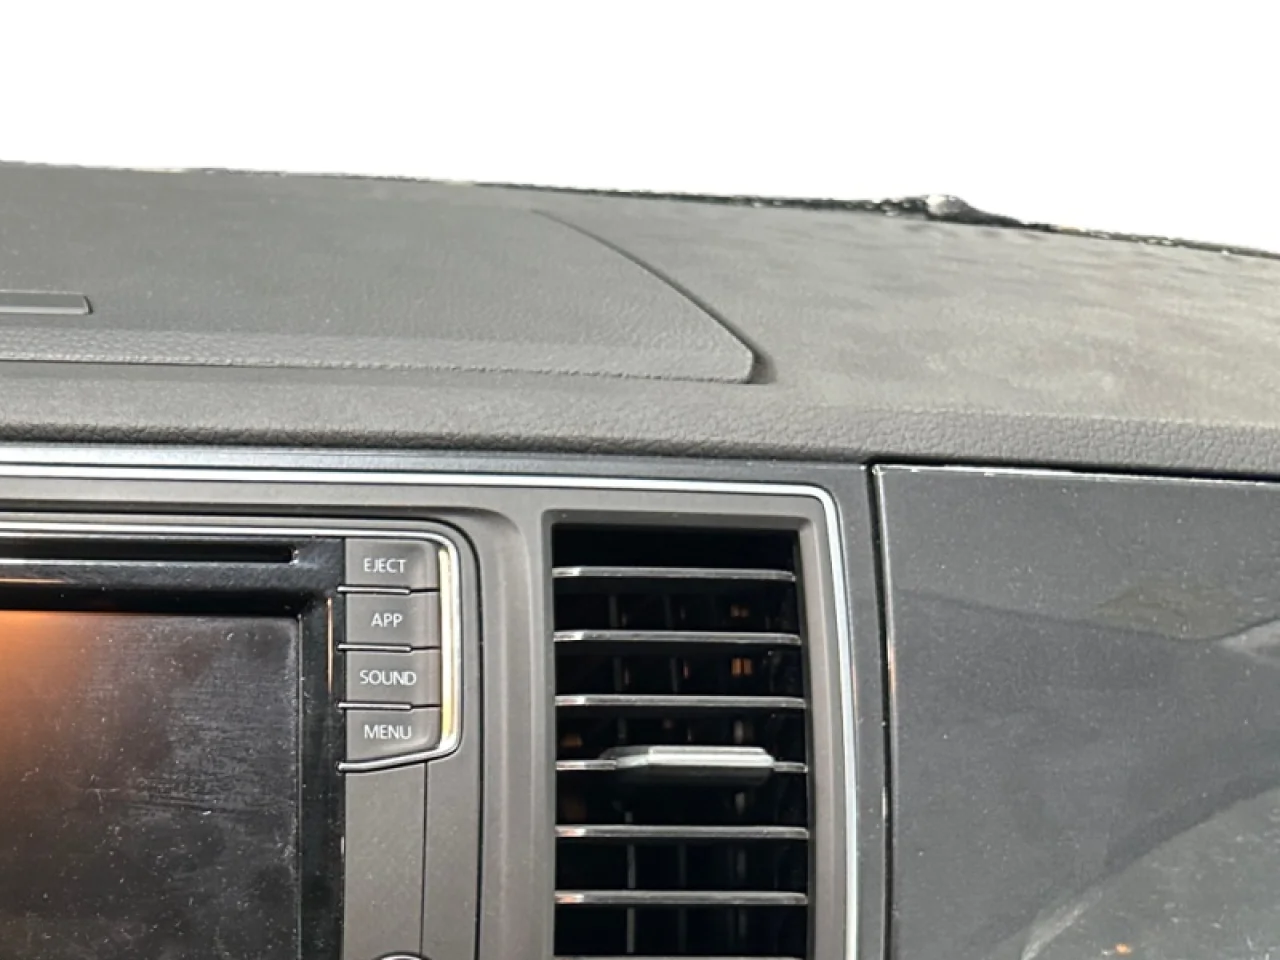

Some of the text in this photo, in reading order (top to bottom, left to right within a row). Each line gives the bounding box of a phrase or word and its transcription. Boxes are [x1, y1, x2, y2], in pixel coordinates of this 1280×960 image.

[364, 558, 407, 574] EJECT
[370, 612, 403, 628] APP
[359, 670, 417, 687] SOUND
[363, 724, 412, 740] MENU
